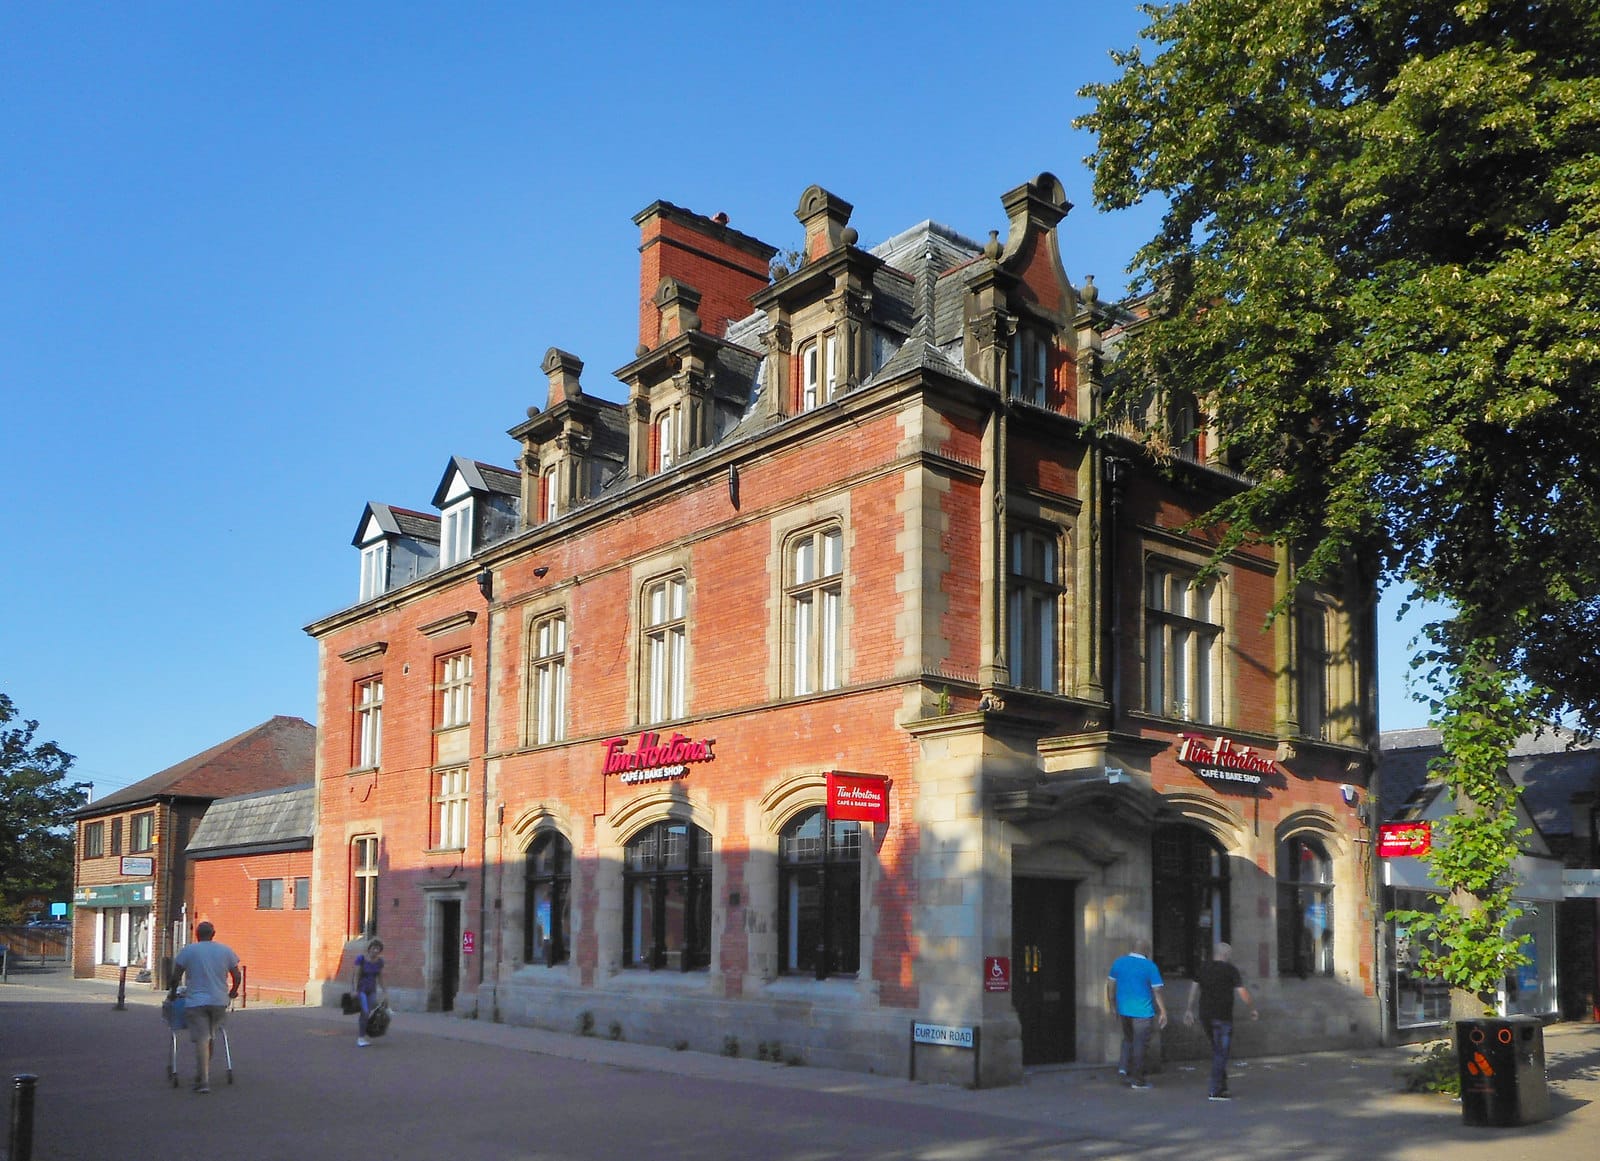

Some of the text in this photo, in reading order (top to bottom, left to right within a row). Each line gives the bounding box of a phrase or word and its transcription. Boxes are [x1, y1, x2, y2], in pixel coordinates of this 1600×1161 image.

[601, 730, 709, 775] Tim Hortons
[1177, 732, 1278, 775] Tim Hortons
[644, 767, 663, 780] BAKE
[664, 765, 684, 777] SHOP
[1200, 768, 1219, 779] CAFÉ
[1225, 772, 1244, 782] BAKE
[1243, 774, 1261, 784] SHOP
[836, 785, 881, 800] Tim Hortons
[915, 1027, 972, 1042] CURZON ROAD
